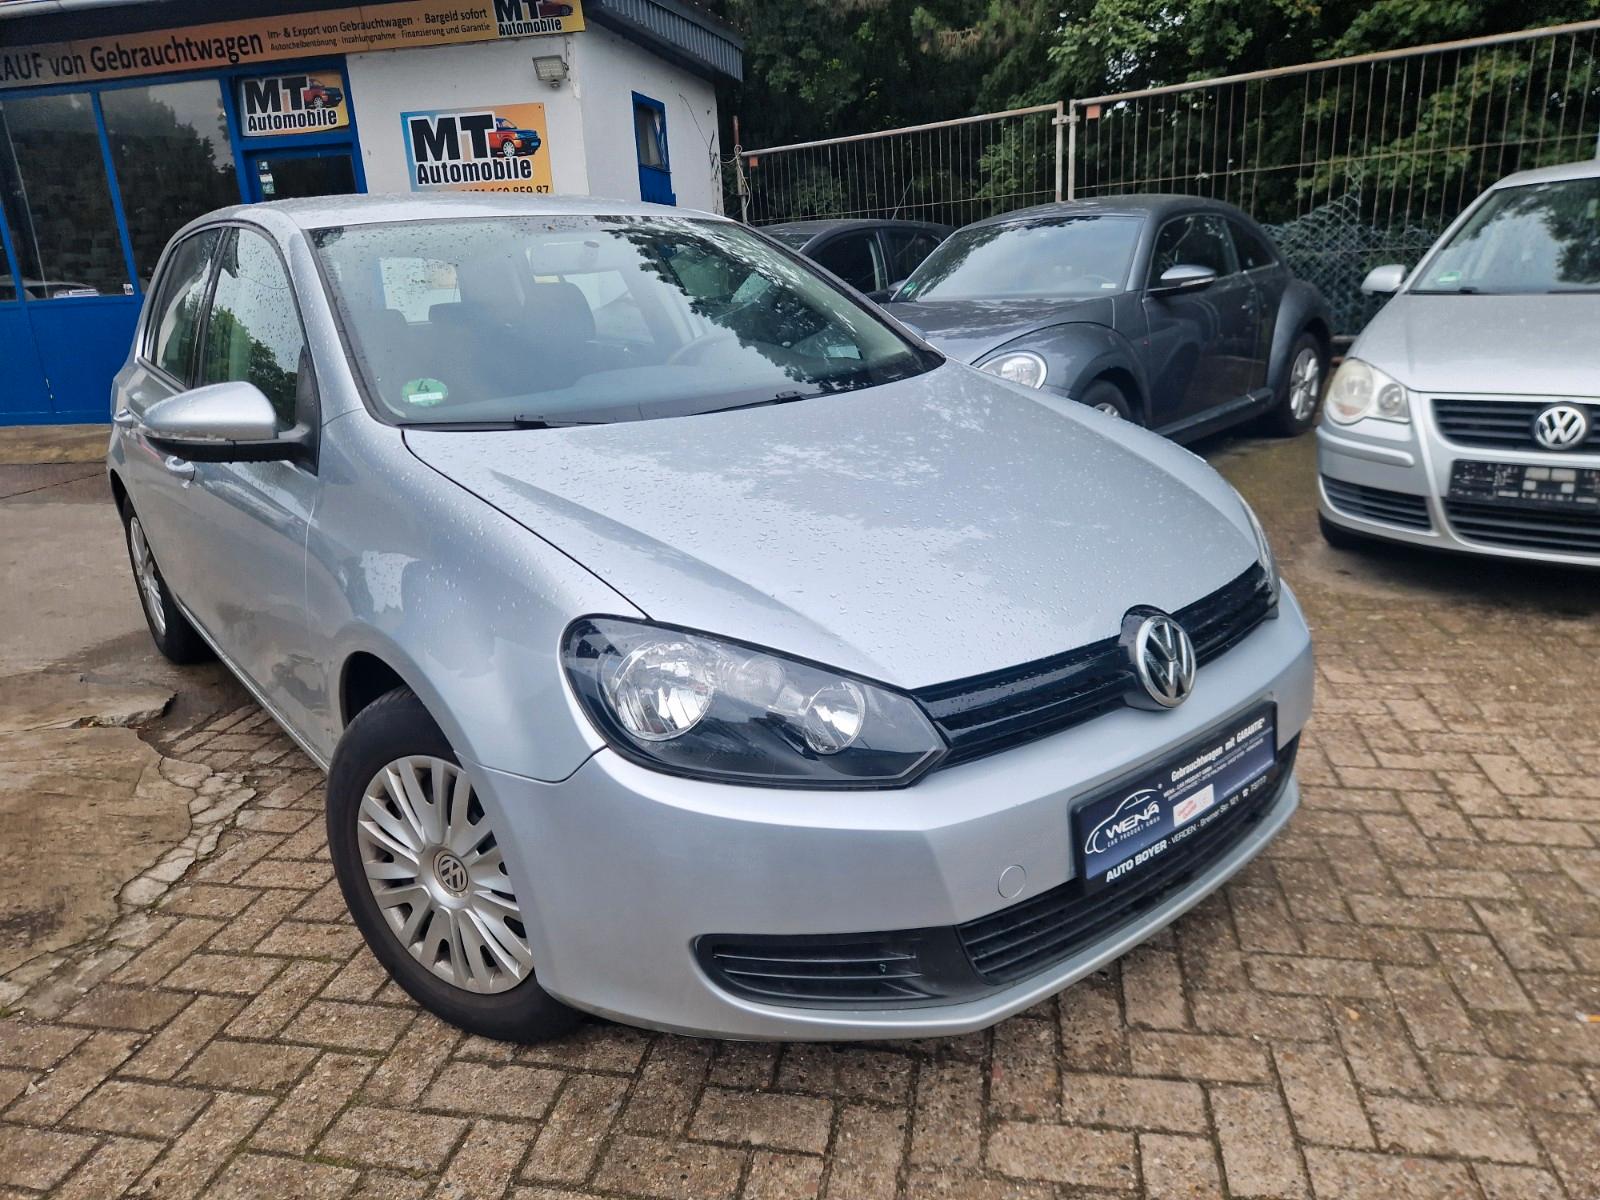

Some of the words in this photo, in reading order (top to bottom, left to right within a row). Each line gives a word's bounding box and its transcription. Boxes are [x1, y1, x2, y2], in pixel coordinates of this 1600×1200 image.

[267, 29, 281, 39] Im-
[283, 27, 291, 38] &
[293, 25, 321, 38] Export
[321, 24, 338, 34] von
[340, 16, 413, 31] Gebrauchtwagen
[424, 10, 459, 25] Bargeld
[460, 8, 488, 20] sofort
[494, 0, 541, 22] MT
[499, 18, 562, 36] Automobile
[401, 26, 445, 37] Finanzierung
[446, 25, 460, 34] und
[460, 23, 491, 33] Garantie
[0, 53, 42, 81] AUF
[49, 54, 86, 77] von
[90, 33, 263, 73] Gebrauchtwagen
[244, 76, 308, 114] MT
[247, 109, 337, 132] Automobile
[410, 114, 495, 162] MT
[417, 158, 532, 185] Automobile
[1171, 746, 1223, 782] Gebrauchtwagen
[1105, 801, 1160, 839] WENA
[1105, 859, 1134, 883] AUTO
[1134, 839, 1168, 866] BOYER
[1171, 824, 1197, 844] VERDEN
